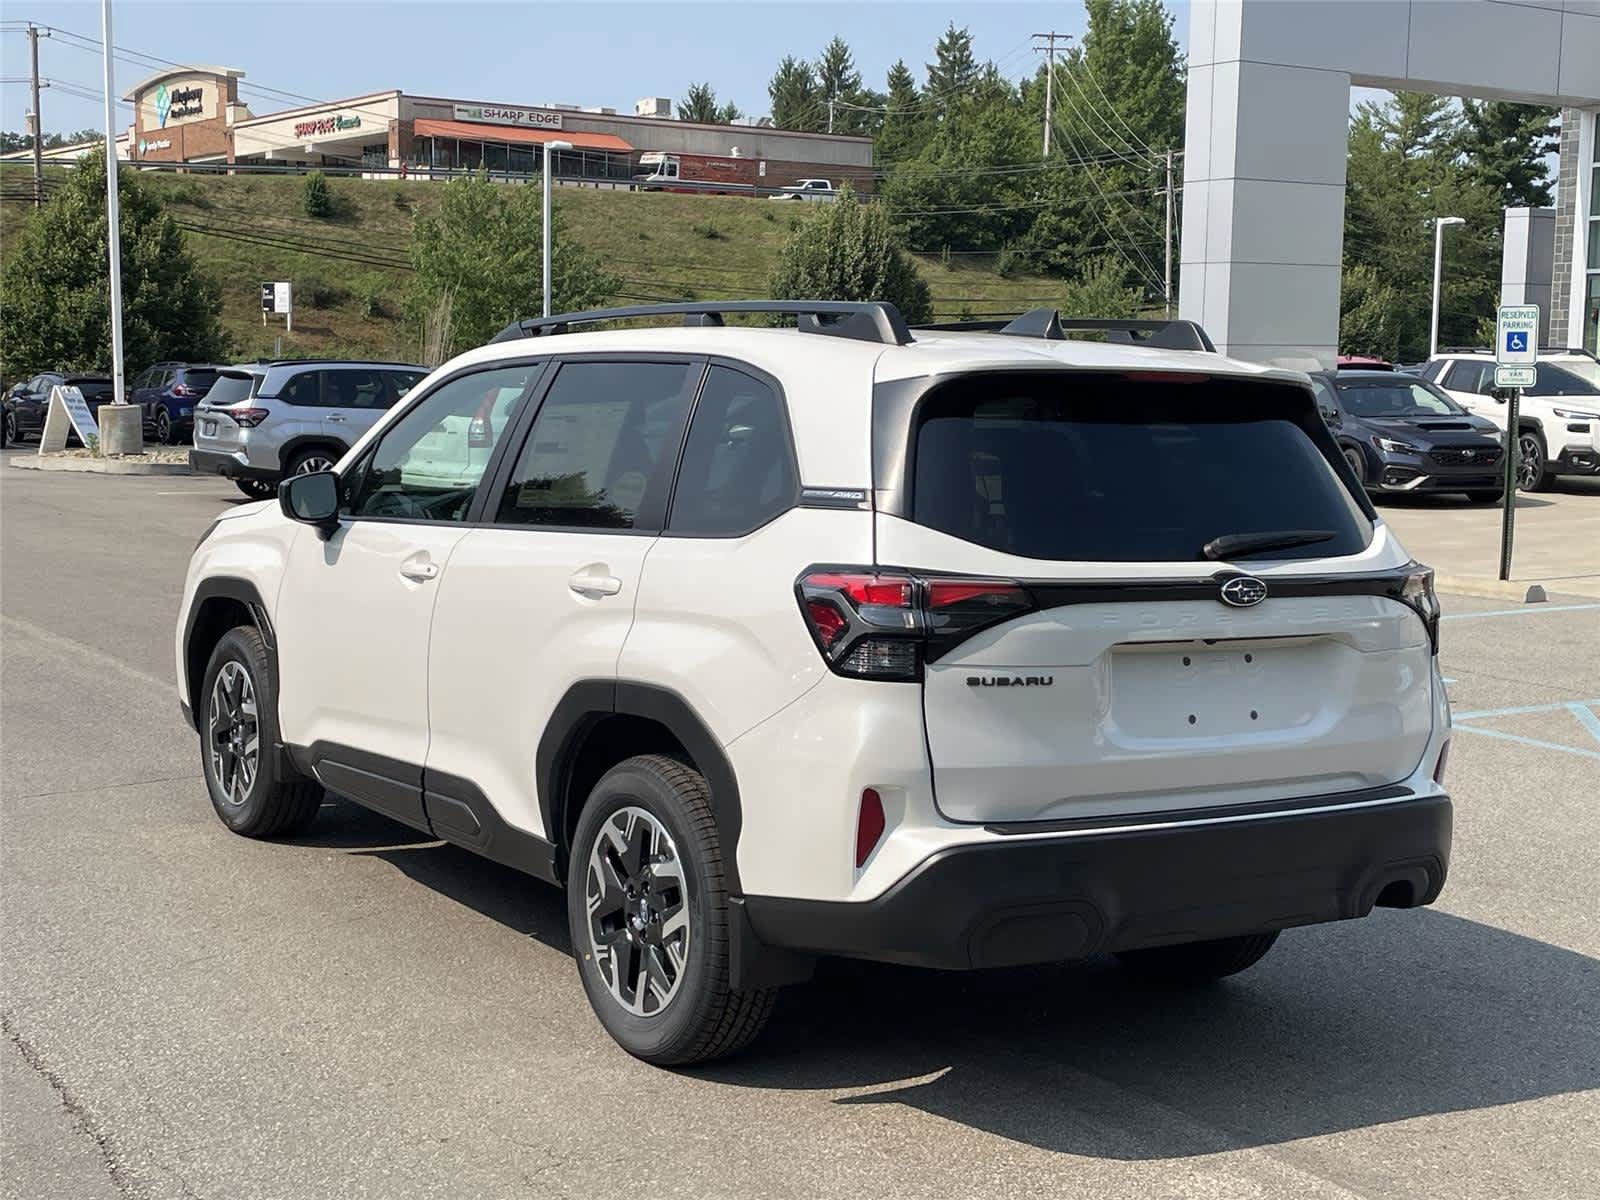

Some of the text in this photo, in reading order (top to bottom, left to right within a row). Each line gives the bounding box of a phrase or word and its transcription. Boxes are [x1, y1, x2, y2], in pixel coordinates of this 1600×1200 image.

[484, 109, 524, 120] SHARP
[528, 113, 560, 124] EDGE
[1501, 311, 1536, 319] RESERVED
[966, 676, 1053, 686] SUBARU
